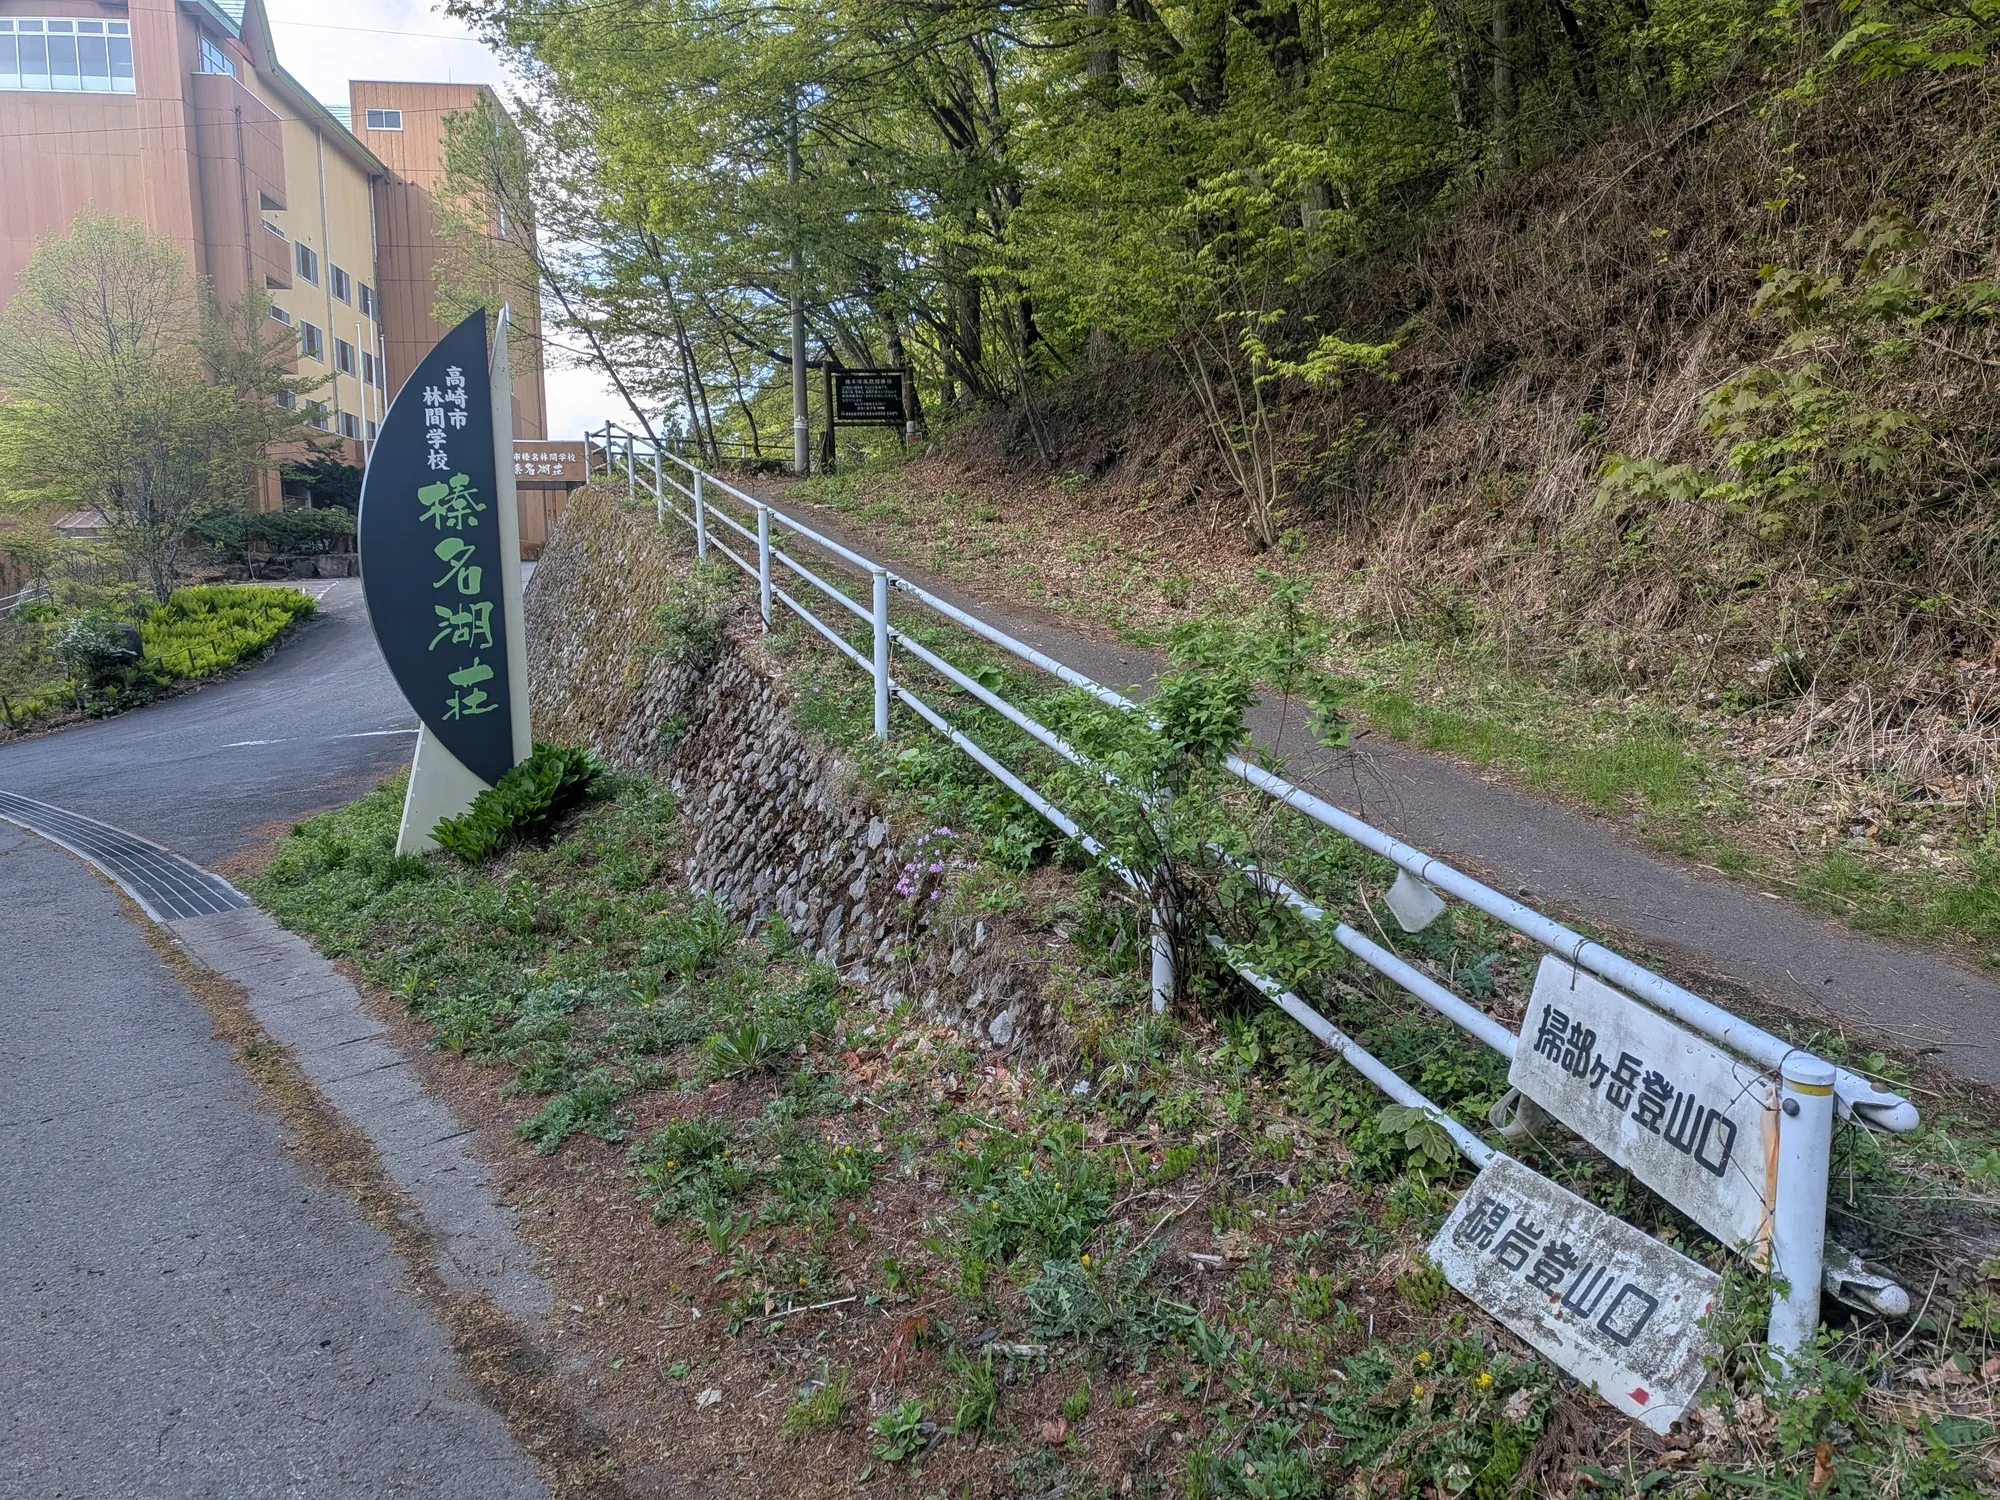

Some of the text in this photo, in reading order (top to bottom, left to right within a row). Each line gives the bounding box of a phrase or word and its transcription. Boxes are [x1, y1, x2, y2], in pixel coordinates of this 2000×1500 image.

[422, 386, 450, 471] 林間学校
[445, 365, 468, 430] 高崎市
[417, 472, 499, 721] 榛名湖荘
